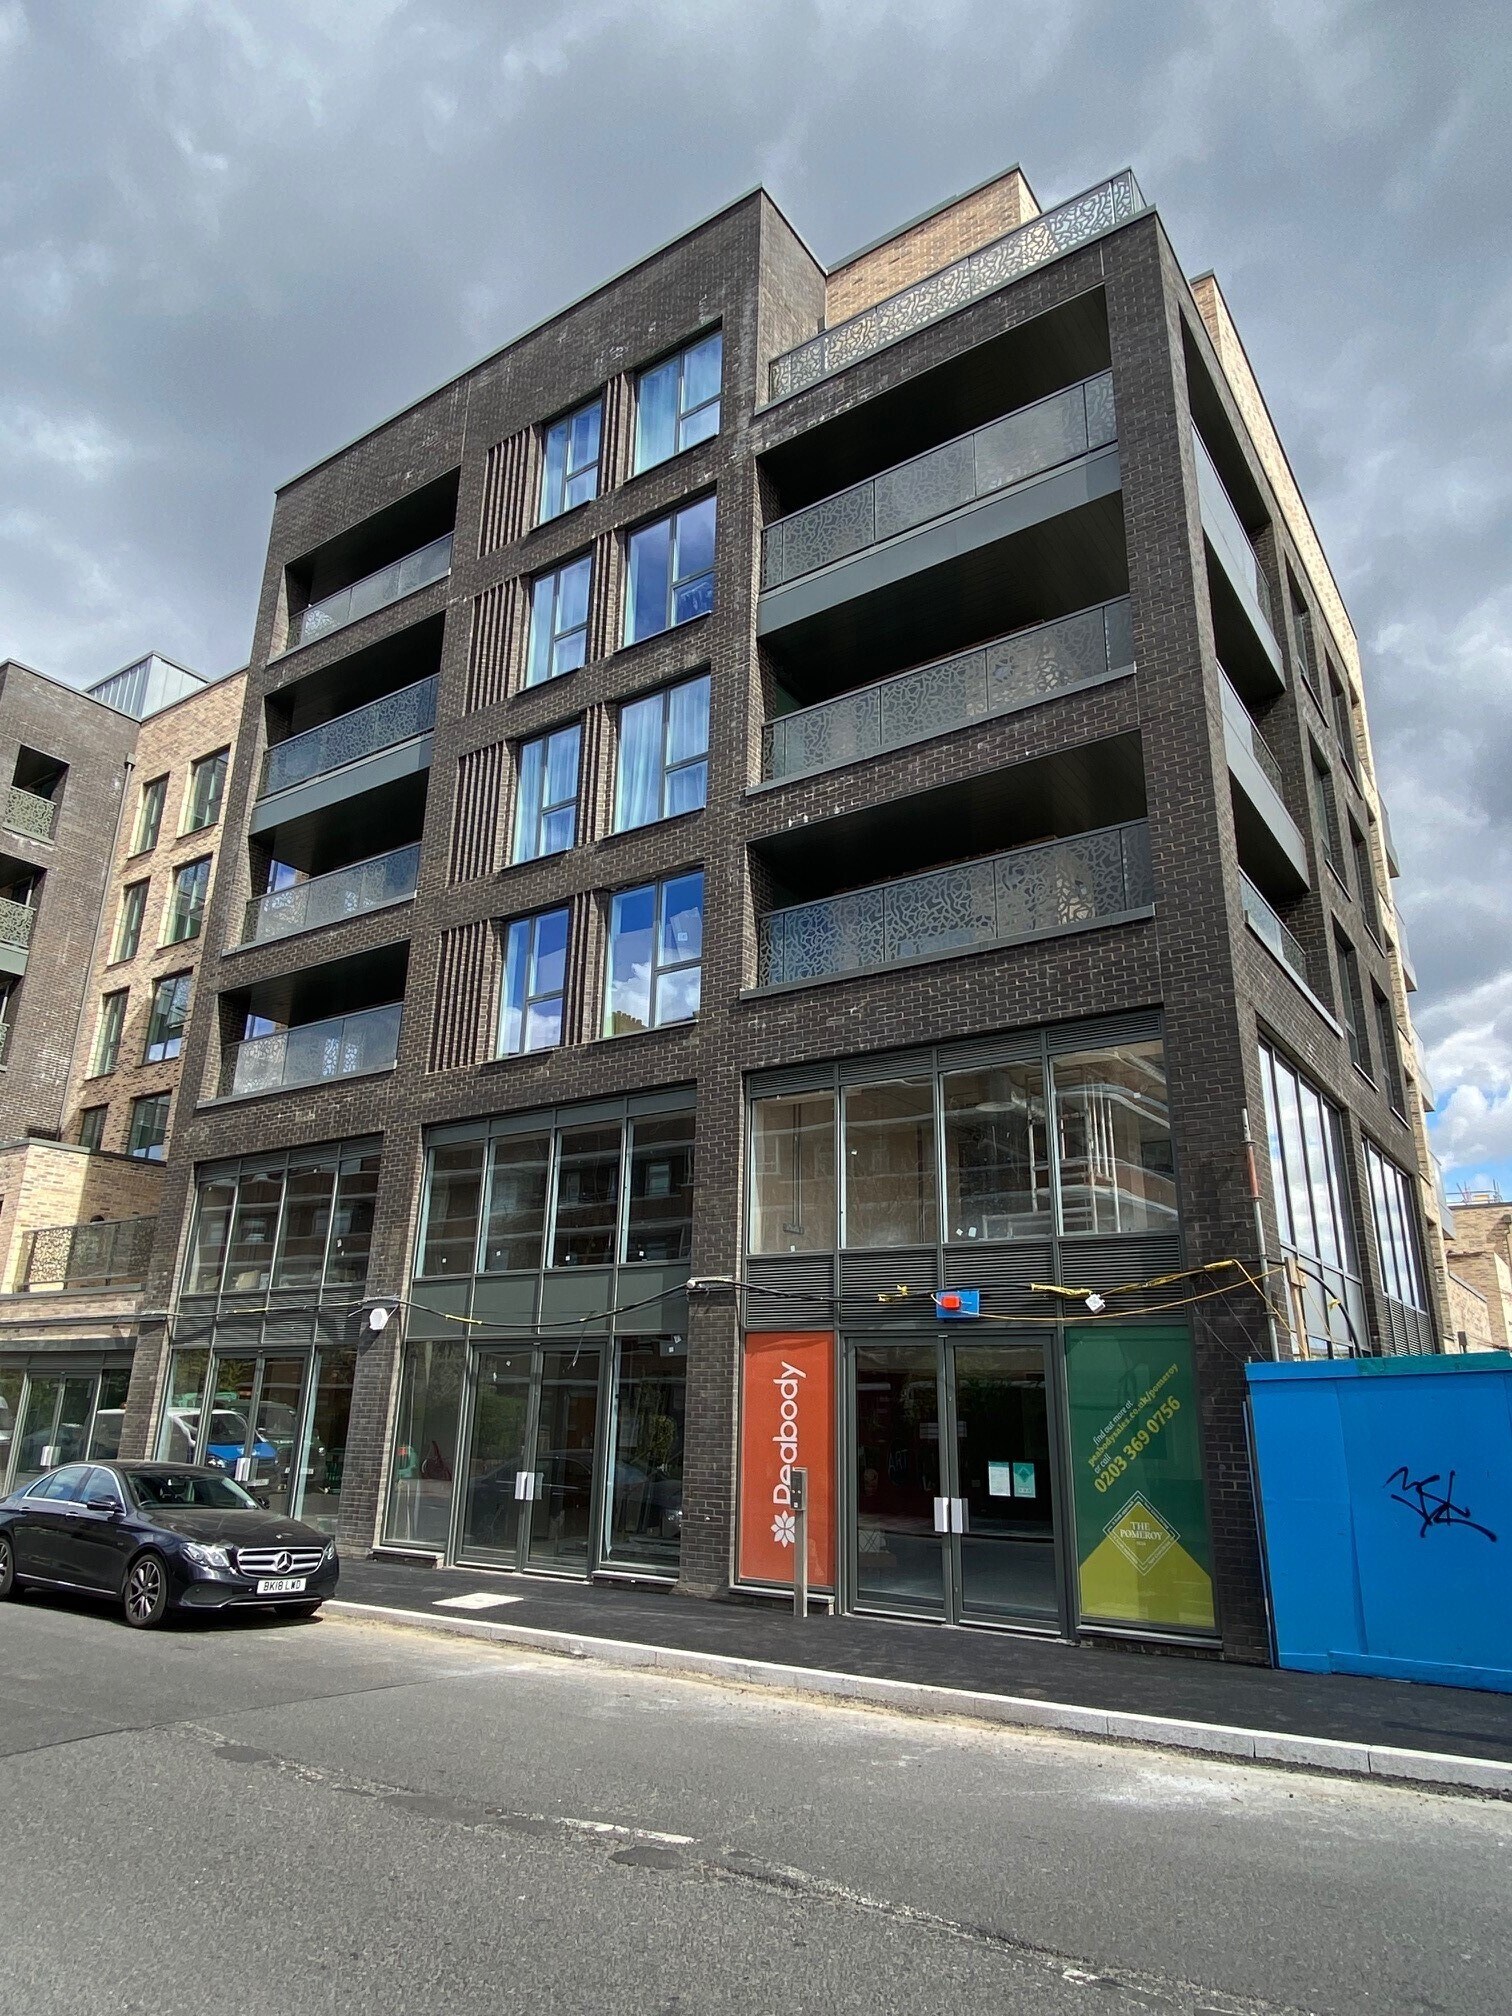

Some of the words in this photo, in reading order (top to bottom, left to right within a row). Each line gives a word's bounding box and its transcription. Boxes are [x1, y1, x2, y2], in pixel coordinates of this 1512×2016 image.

[1088, 1363, 1179, 1467] peabodysales.co.uk/pomeroy
[1092, 1430, 1107, 1446] find
[1104, 1421, 1115, 1434] out
[1112, 1405, 1128, 1424] more
[1125, 1400, 1134, 1411] at
[1094, 1455, 1128, 1493] 0203
[1122, 1429, 1150, 1461] 369
[1146, 1395, 1181, 1434] 0756
[1094, 1464, 1102, 1475] or
[1099, 1453, 1112, 1468] call
[1119, 1528, 1163, 1541] POMEROY
[1130, 1521, 1151, 1531] THE
